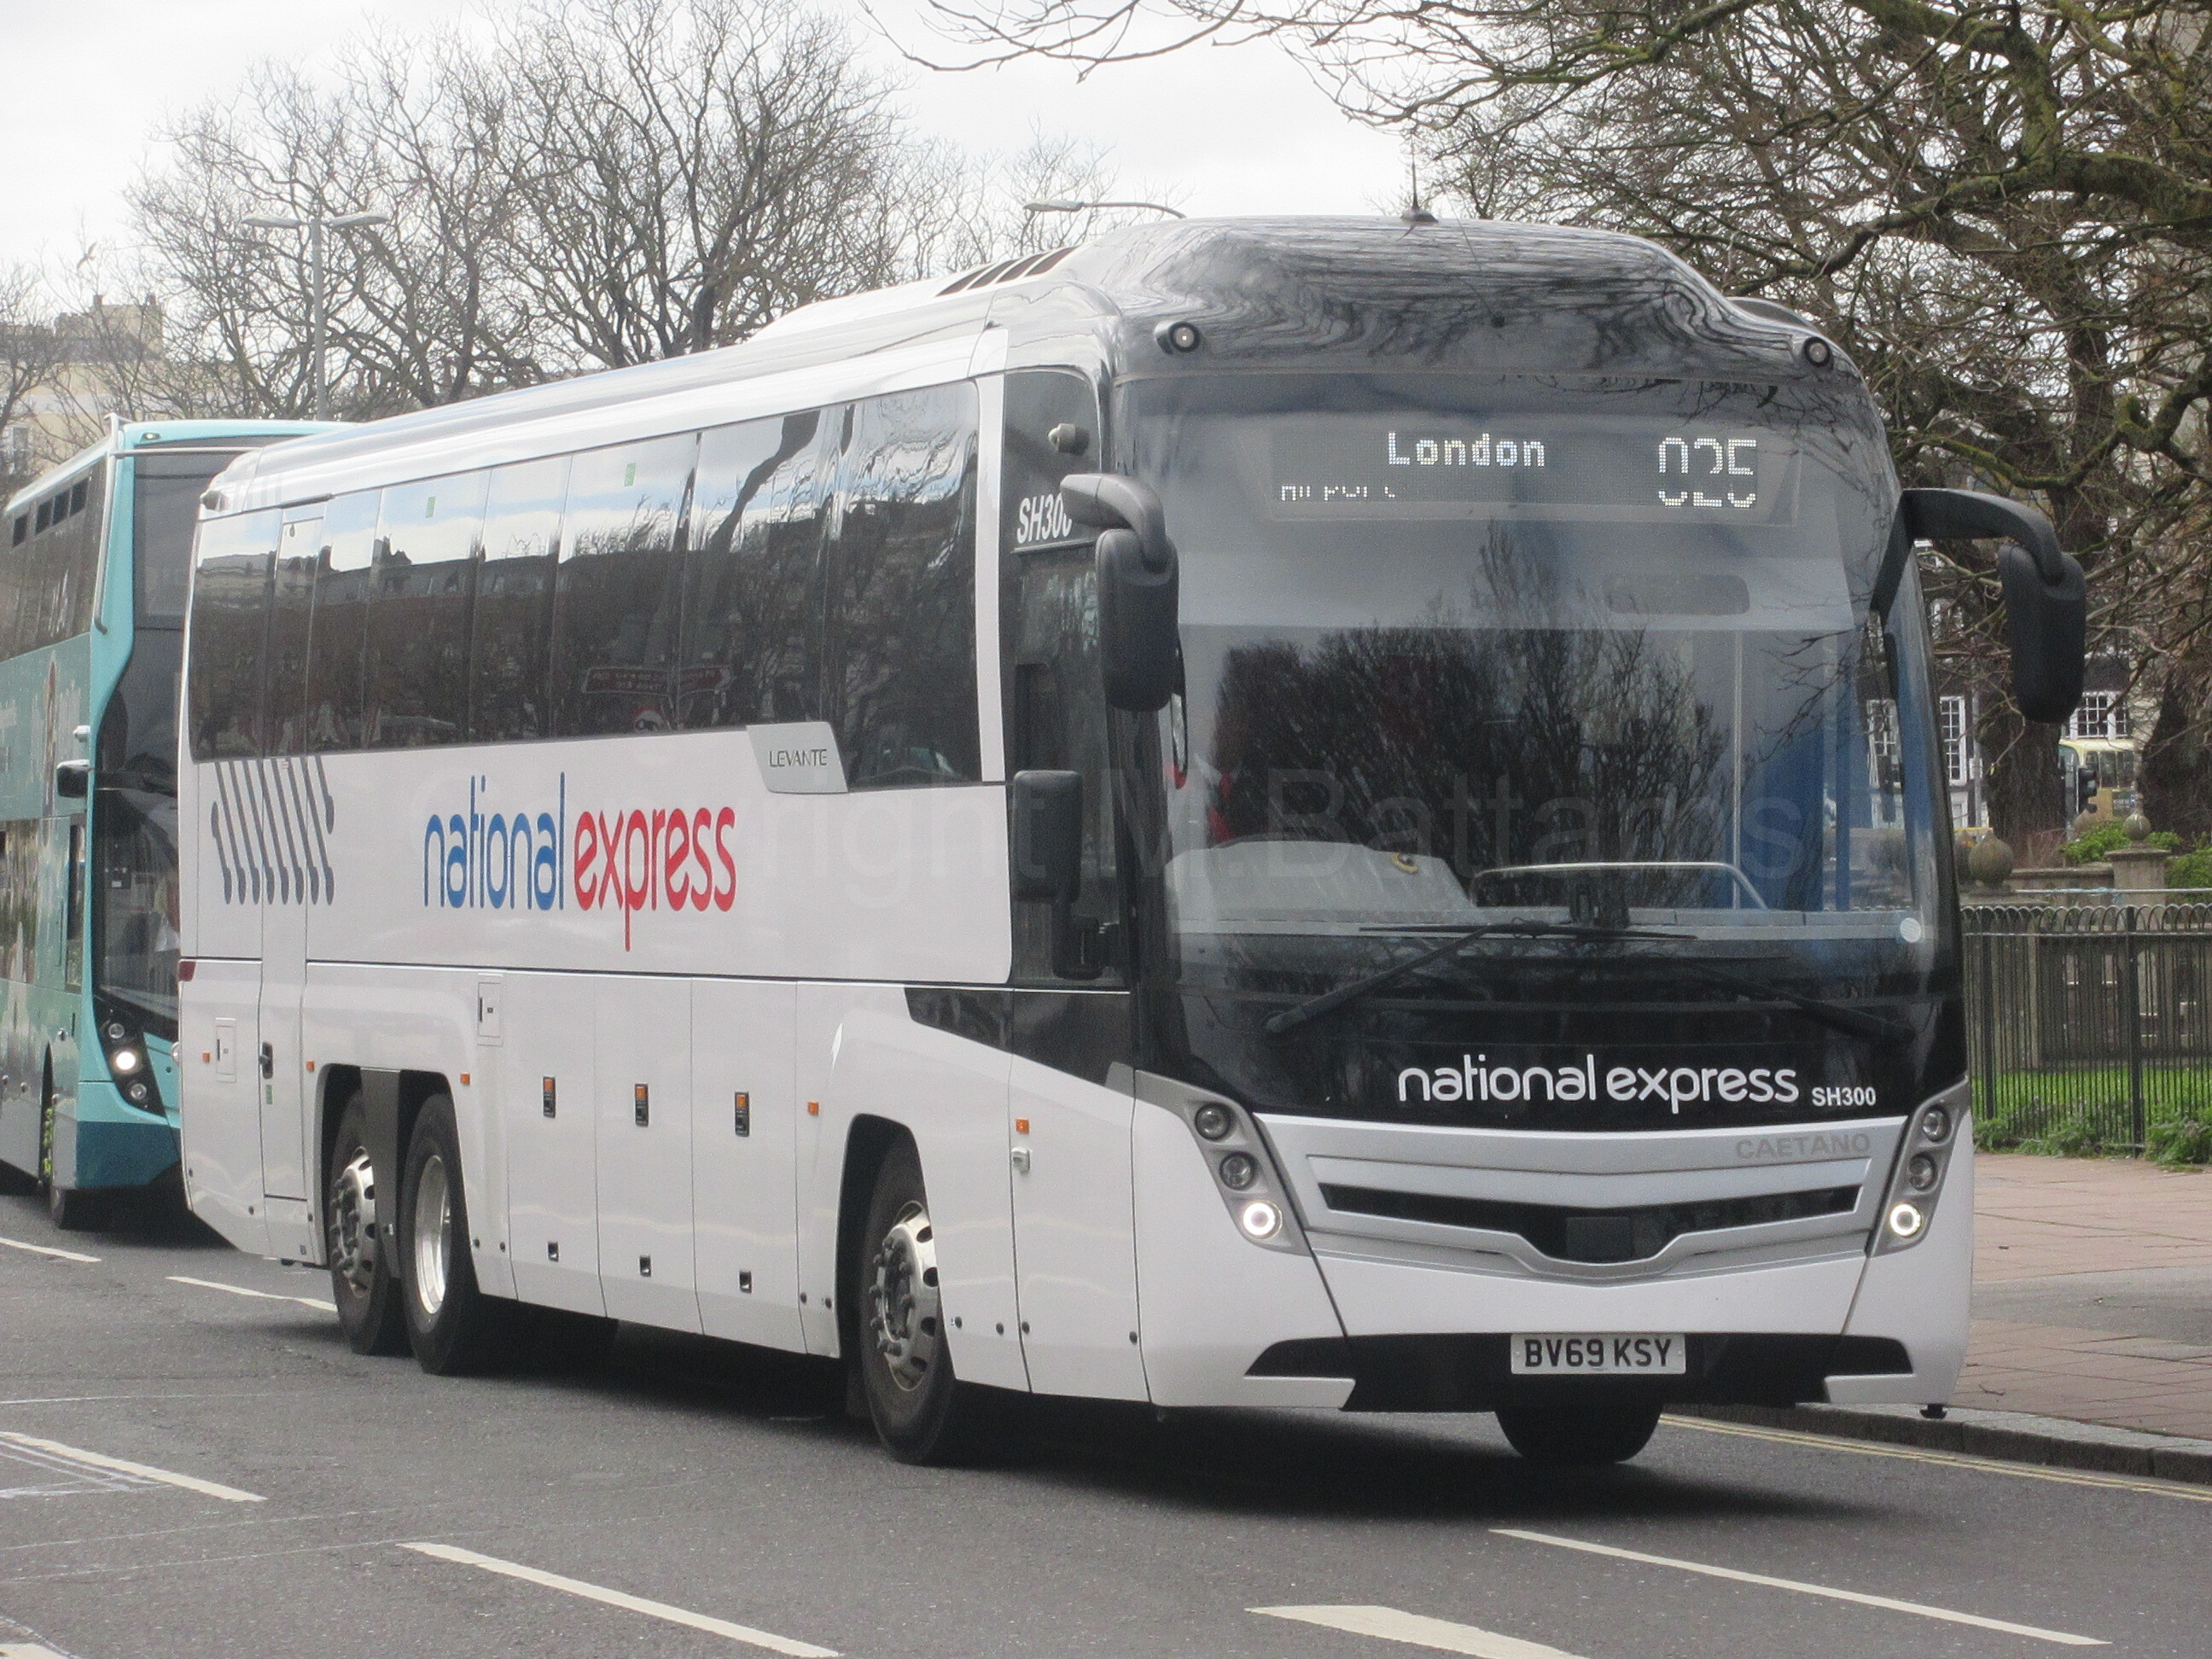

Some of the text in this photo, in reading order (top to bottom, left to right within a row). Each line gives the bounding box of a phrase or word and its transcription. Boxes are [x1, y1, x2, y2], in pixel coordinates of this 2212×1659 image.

[1388, 432, 1545, 467] London
[769, 748, 828, 768] LEVANTE
[424, 771, 737, 952] national express
[1398, 1054, 1877, 1114] national express SH300
[1735, 1132, 1871, 1160] CAETANO
[1524, 1338, 1672, 1367] BV69 KSY
